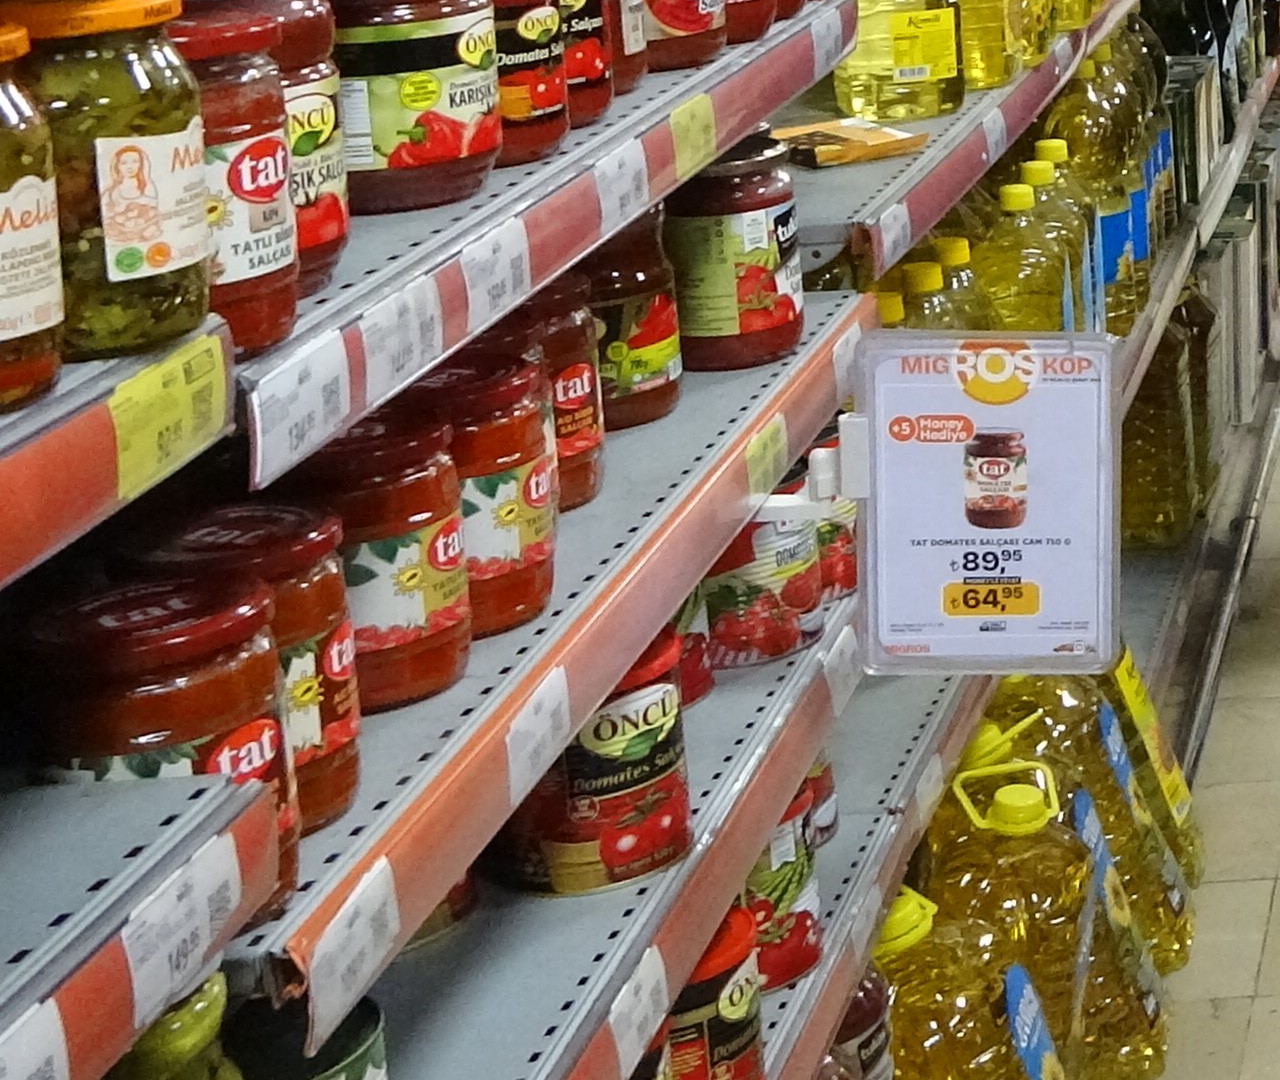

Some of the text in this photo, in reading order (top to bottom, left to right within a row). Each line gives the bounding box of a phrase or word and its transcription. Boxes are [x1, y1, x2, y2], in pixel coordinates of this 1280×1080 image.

[907, 13, 941, 29] Komili
[465, 30, 494, 55] ÖNC
[495, 50, 550, 67] Domates
[289, 100, 332, 135] NCÜ
[238, 144, 287, 192] tat
[231, 237, 273, 257] TATLI
[249, 245, 292, 271] SALÇAS
[554, 369, 592, 403] tat
[892, 422, 911, 435] +5
[919, 418, 965, 432] Money
[919, 430, 968, 443] Hediye
[529, 467, 550, 501] ta
[910, 539, 929, 548] TAT
[931, 539, 977, 547] DOMATES
[1022, 538, 1043, 547] CAM
[328, 634, 355, 675] ta
[593, 688, 675, 743] ÖNCÜ
[216, 725, 278, 779] tat
[572, 763, 651, 793] Domates
[729, 975, 756, 1007] ÖN
